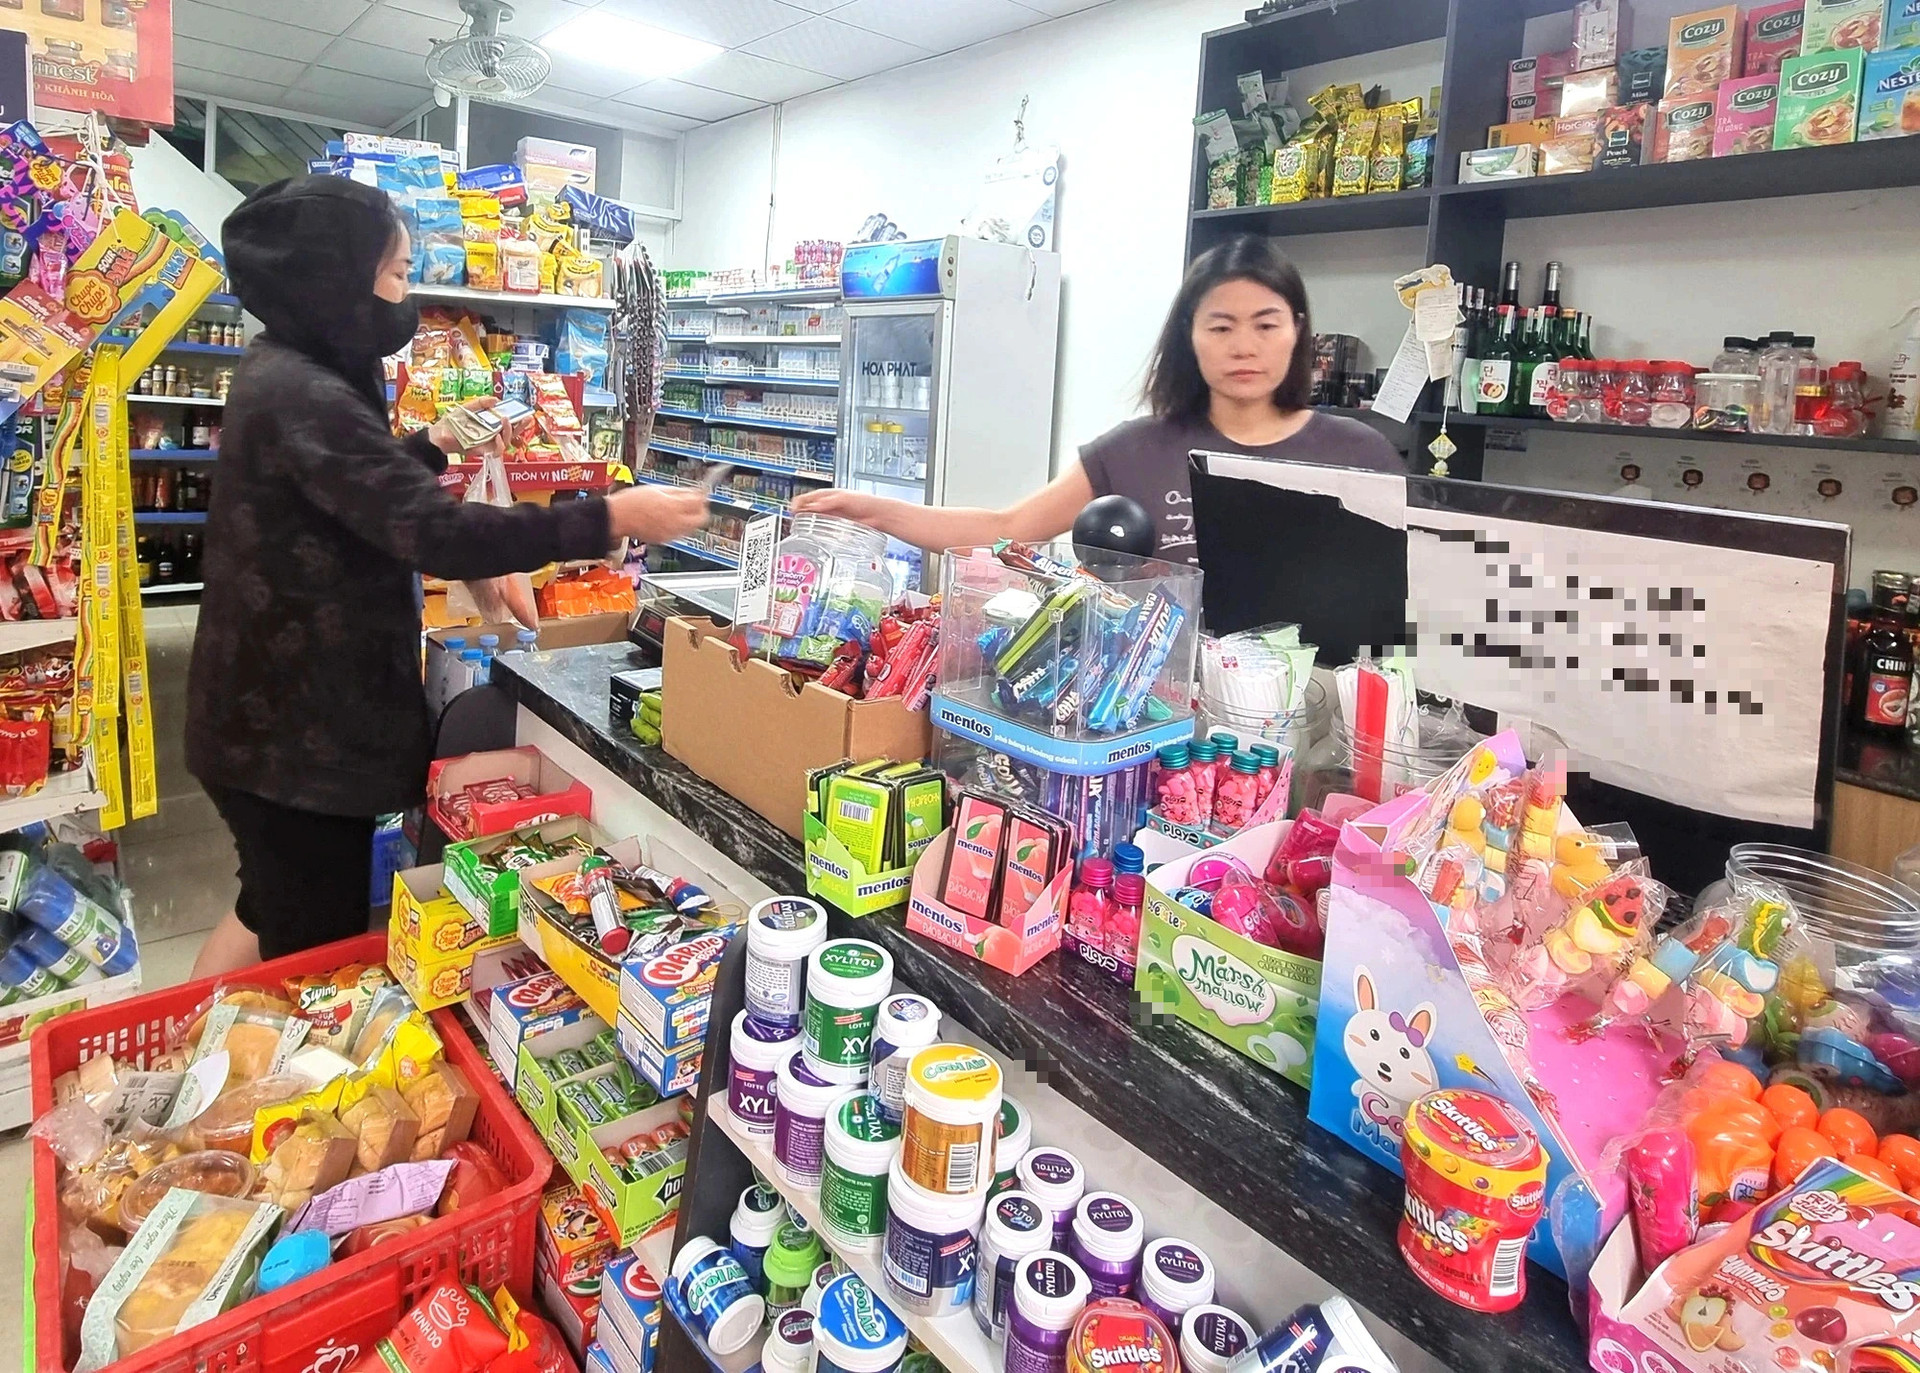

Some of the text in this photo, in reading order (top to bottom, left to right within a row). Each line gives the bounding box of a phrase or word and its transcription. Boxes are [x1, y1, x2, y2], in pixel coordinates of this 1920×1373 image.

[1684, 22, 1720, 39] Cozy
[1763, 15, 1801, 32] Cozy
[1513, 61, 1534, 71] Cozy
[1797, 67, 1840, 87] Cozy
[1879, 72, 1920, 91] NESTE
[1513, 97, 1533, 108] Cozy
[1737, 86, 1772, 103] Cozy
[1672, 105, 1708, 121] Cozy
[70, 281, 97, 306] Chupa
[79, 287, 107, 314] Chups
[511, 470, 537, 482] TRÒN
[1876, 658, 1910, 672] CHIN
[941, 709, 993, 738] mentos
[1108, 742, 1151, 764] mentos
[957, 839, 995, 859] mentos
[810, 853, 849, 880] mentos
[1009, 860, 1044, 884] mentos
[858, 875, 912, 897] mentos
[912, 899, 964, 934] mentos
[1026, 911, 1060, 938] mentos
[823, 952, 878, 969] XYLITOL
[1179, 948, 1266, 999] Marsh
[299, 983, 339, 1011] Swing
[743, 1081, 765, 1092] LOTTE
[1431, 1098, 1498, 1152] Skittles
[1035, 1163, 1073, 1175] XYLITOL
[1003, 1201, 1037, 1225] XYLITOL
[1091, 1209, 1131, 1221] XYLITOL
[1159, 1255, 1202, 1273] XYLITOL
[1751, 1220, 1920, 1311] Skittles
[1045, 1260, 1056, 1297] XYLITOL
[1214, 1316, 1228, 1352] XYLITOL
[1091, 1344, 1163, 1369] Skittles
